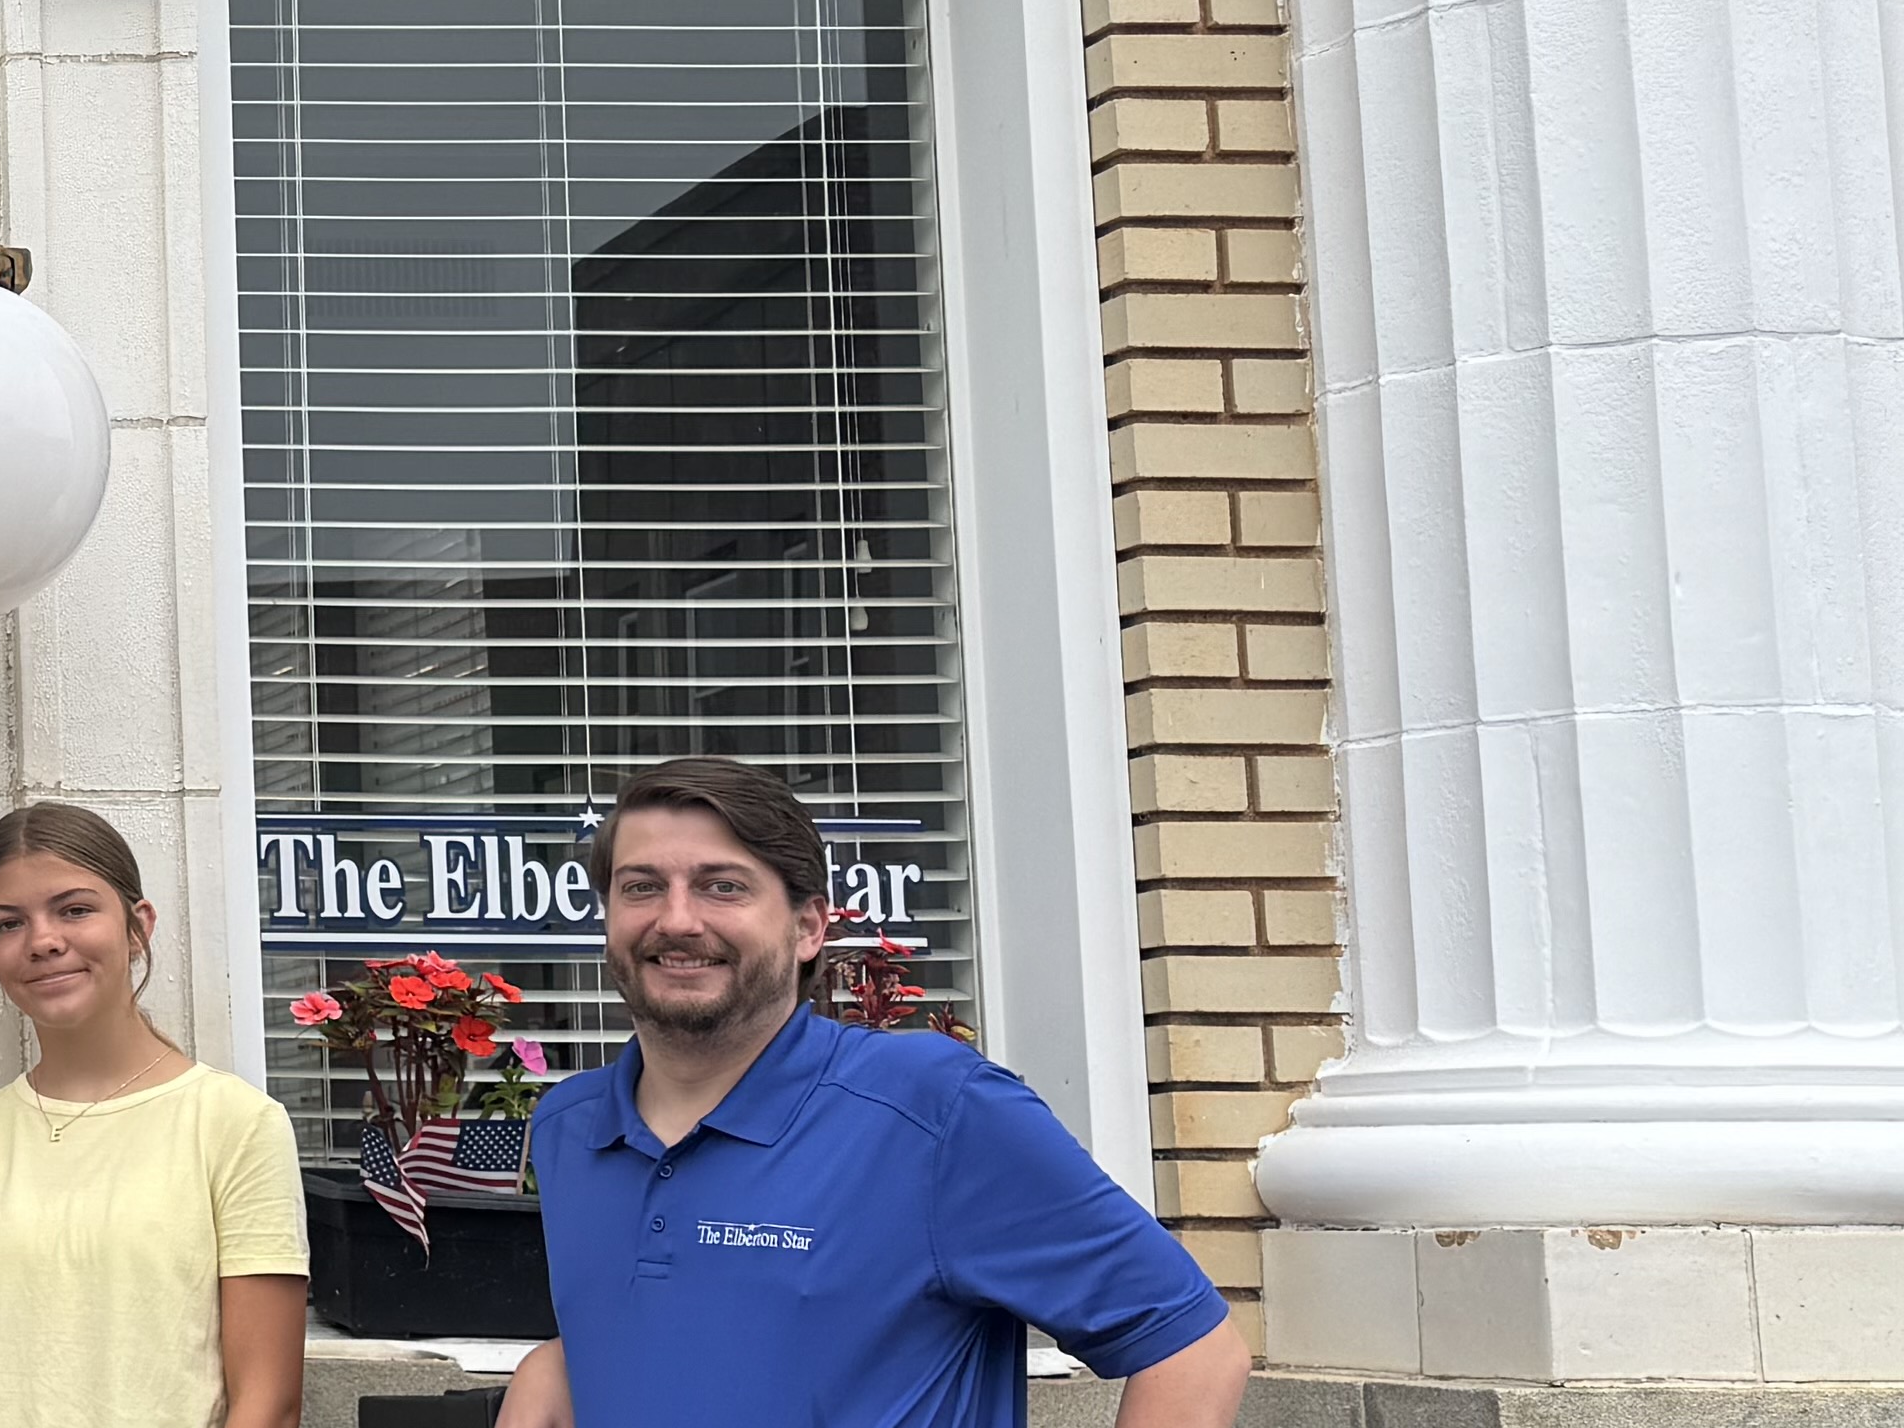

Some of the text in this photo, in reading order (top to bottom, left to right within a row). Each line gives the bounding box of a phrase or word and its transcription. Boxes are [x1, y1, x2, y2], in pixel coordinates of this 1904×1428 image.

[260, 833, 404, 922] The
[827, 842, 921, 925] tar
[697, 1225, 812, 1250] The Elberton Star
